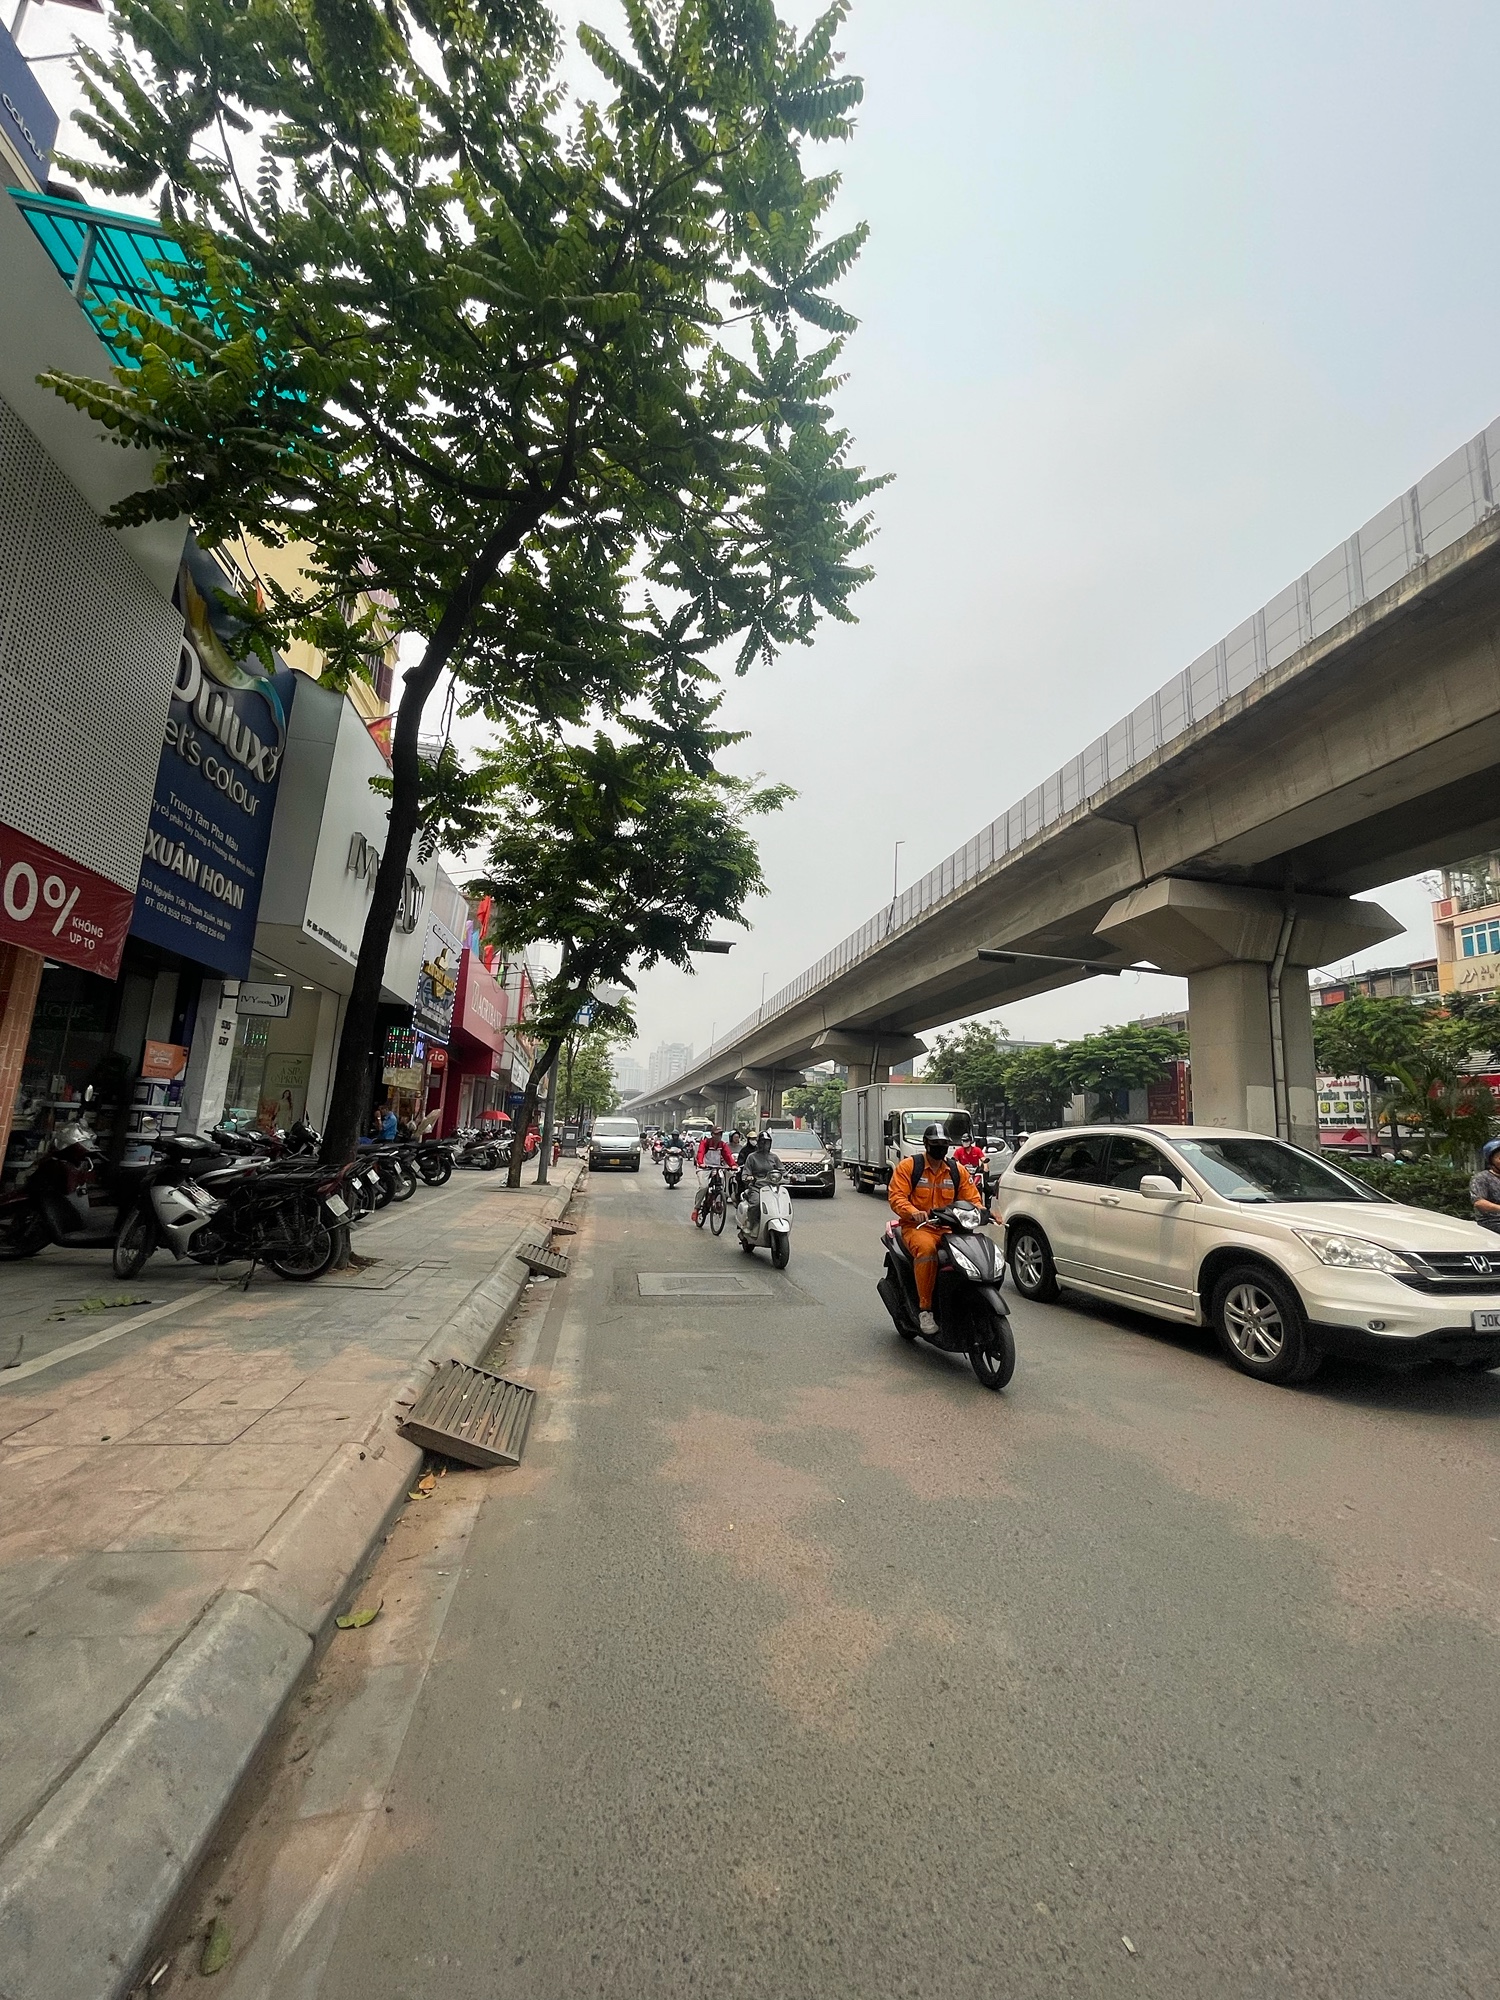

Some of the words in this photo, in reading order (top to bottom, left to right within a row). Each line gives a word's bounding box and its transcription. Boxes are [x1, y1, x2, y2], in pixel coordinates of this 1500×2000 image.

[203, 756, 260, 817] colour
[169, 791, 194, 820] Trung
[194, 810, 210, 831] Tâm
[211, 823, 225, 842] Pha
[225, 834, 239, 852] Màu
[144, 828, 200, 883] XUÂN
[200, 864, 245, 910] HOAN
[141, 877, 153, 890] 533
[156, 901, 168, 914] 024
[72, 916, 104, 938] KHÔNG
[69, 932, 83, 945] UP
[83, 937, 96, 950] TO
[240, 995, 259, 1003] IVY
[429, 1050, 445, 1060] ria
